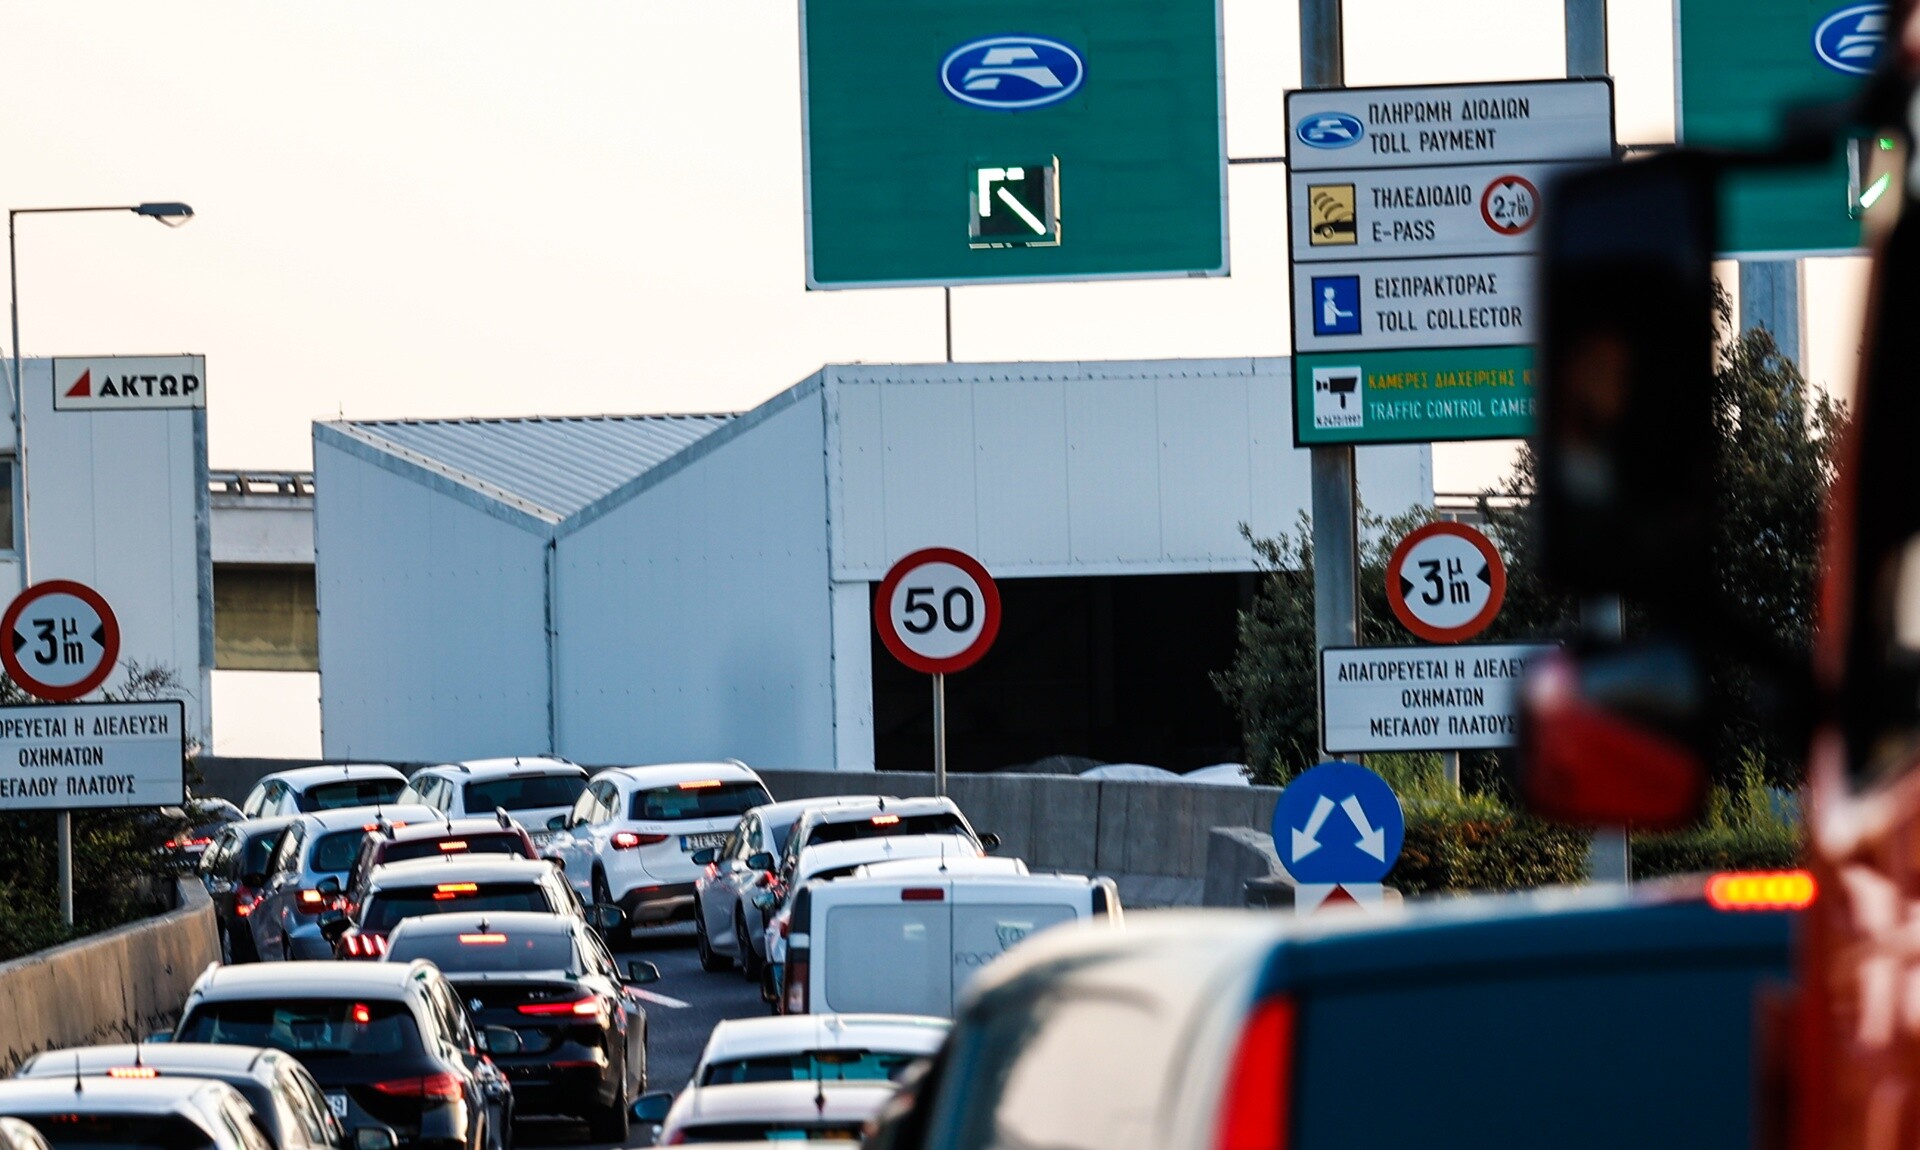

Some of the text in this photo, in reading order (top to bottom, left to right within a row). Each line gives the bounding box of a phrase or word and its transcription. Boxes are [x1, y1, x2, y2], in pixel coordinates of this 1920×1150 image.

[1368, 97, 1530, 125] ΠΛΗΡΩΜΗ ΔΙΟΔΙΩΝ
[1370, 128, 1497, 154] TOLL PAYMENT
[1371, 185, 1472, 209] ΤΗΛΕΔΙΟΔΙΟ
[1372, 220, 1436, 243] E-PASS
[1374, 274, 1498, 299] ΕΙΣΠΡΑΚΤΟΡΑΣ
[1377, 306, 1523, 333] TOLL COLLECTOR
[99, 374, 200, 397] ΑΚΤΩΡ
[1368, 371, 1429, 390] ΚΑΜΕΡΕΣ
[1435, 368, 1516, 389] ΔΙΑΧΕΙΡΙΣΗΣ
[1368, 400, 1422, 421] TRAFFIC
[1427, 398, 1486, 420] CONTROL
[1418, 559, 1445, 605] 3
[903, 586, 975, 635] 50
[33, 618, 57, 665] 3
[1338, 658, 1528, 682] ΑΠΑΓΟΡΕΥΕΤΑΙ Η ΔΙΕΛΕΥ
[1401, 687, 1484, 709] ΟΧΗΜΑΤΩΝ
[75, 717, 85, 737] Η
[93, 714, 169, 736] ΔΙΕΛΕΥΣΗ
[1370, 716, 1440, 738] ΜΕΓΑΛΟΥ
[19, 746, 104, 768] ΟΧΗΜΑΤΩΝ
[67, 774, 136, 795] ΠΛΑΤΟΥΣ
